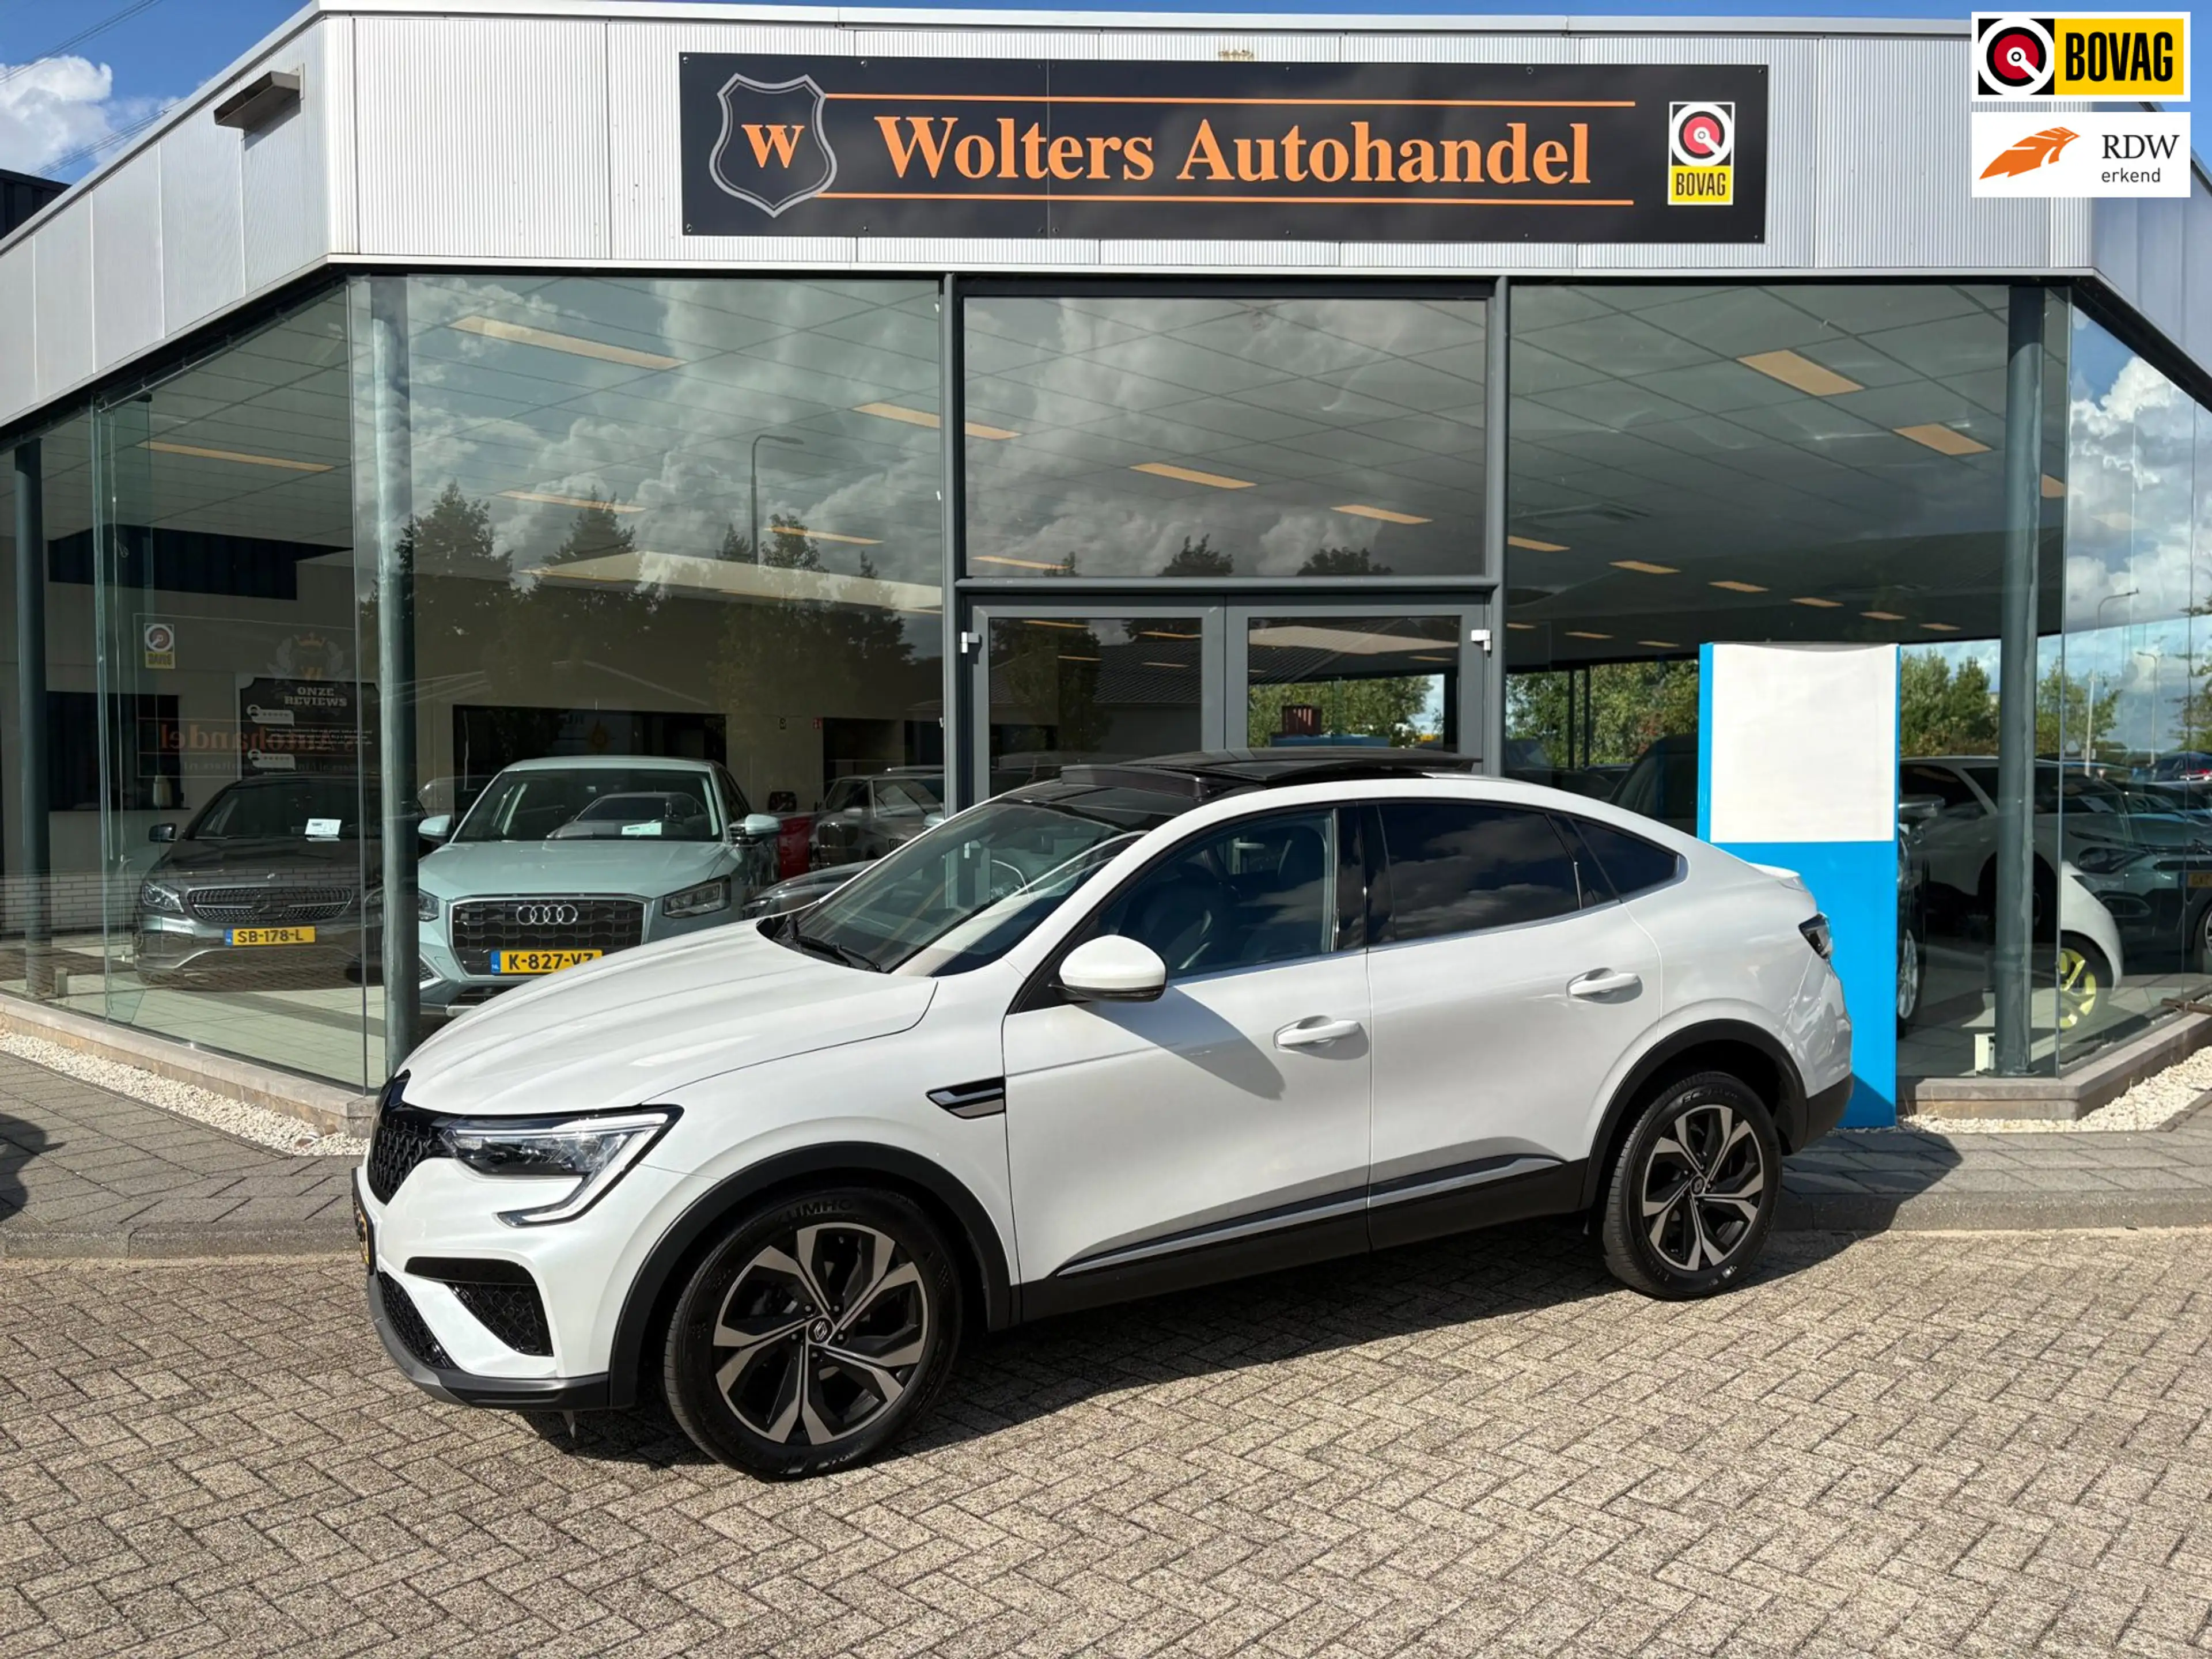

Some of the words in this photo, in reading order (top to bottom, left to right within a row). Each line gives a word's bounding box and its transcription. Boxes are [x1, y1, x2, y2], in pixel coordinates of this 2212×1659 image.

[741, 124, 805, 168] W
[875, 116, 1154, 180] Wolters
[1176, 118, 1590, 184] Autohandel
[1676, 172, 1726, 196] BOVAG
[284, 695, 348, 707] REVIEWS
[297, 686, 335, 697] ONZE
[237, 929, 305, 943] SB-178-L
